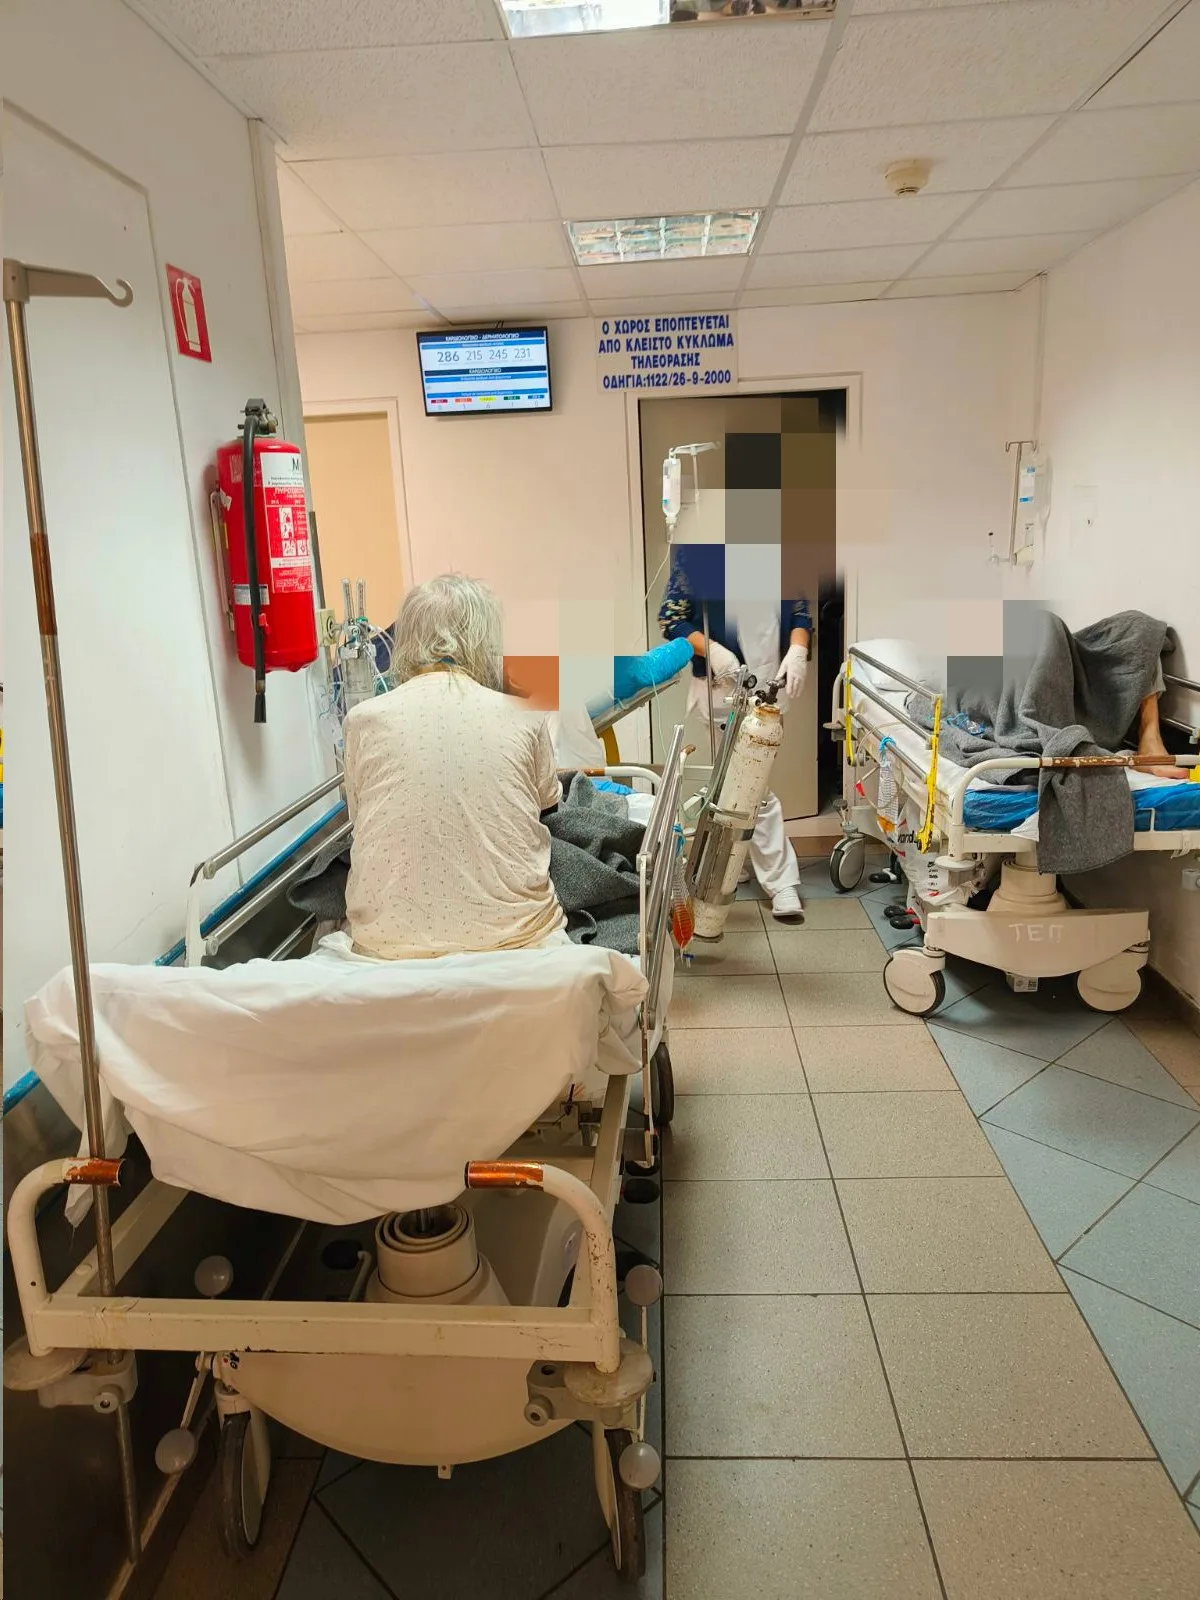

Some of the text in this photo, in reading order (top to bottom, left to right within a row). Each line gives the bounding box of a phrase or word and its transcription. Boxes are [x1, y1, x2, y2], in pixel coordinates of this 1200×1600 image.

[602, 315, 729, 335] Ο ΧΩΡΟΣ ΕΠΟΠΤΕΥΕΤΑΙ
[598, 333, 734, 353] ΑΠΟ ΚΛΕΙΣΤΟ ΚΥΚΛΩΜΑ
[437, 348, 531, 363] 286 215 245 231
[631, 352, 700, 370] ΤΗΛΕΟΡΑΣΗΣ
[1008, 923, 1065, 944] ΤΕΠ
